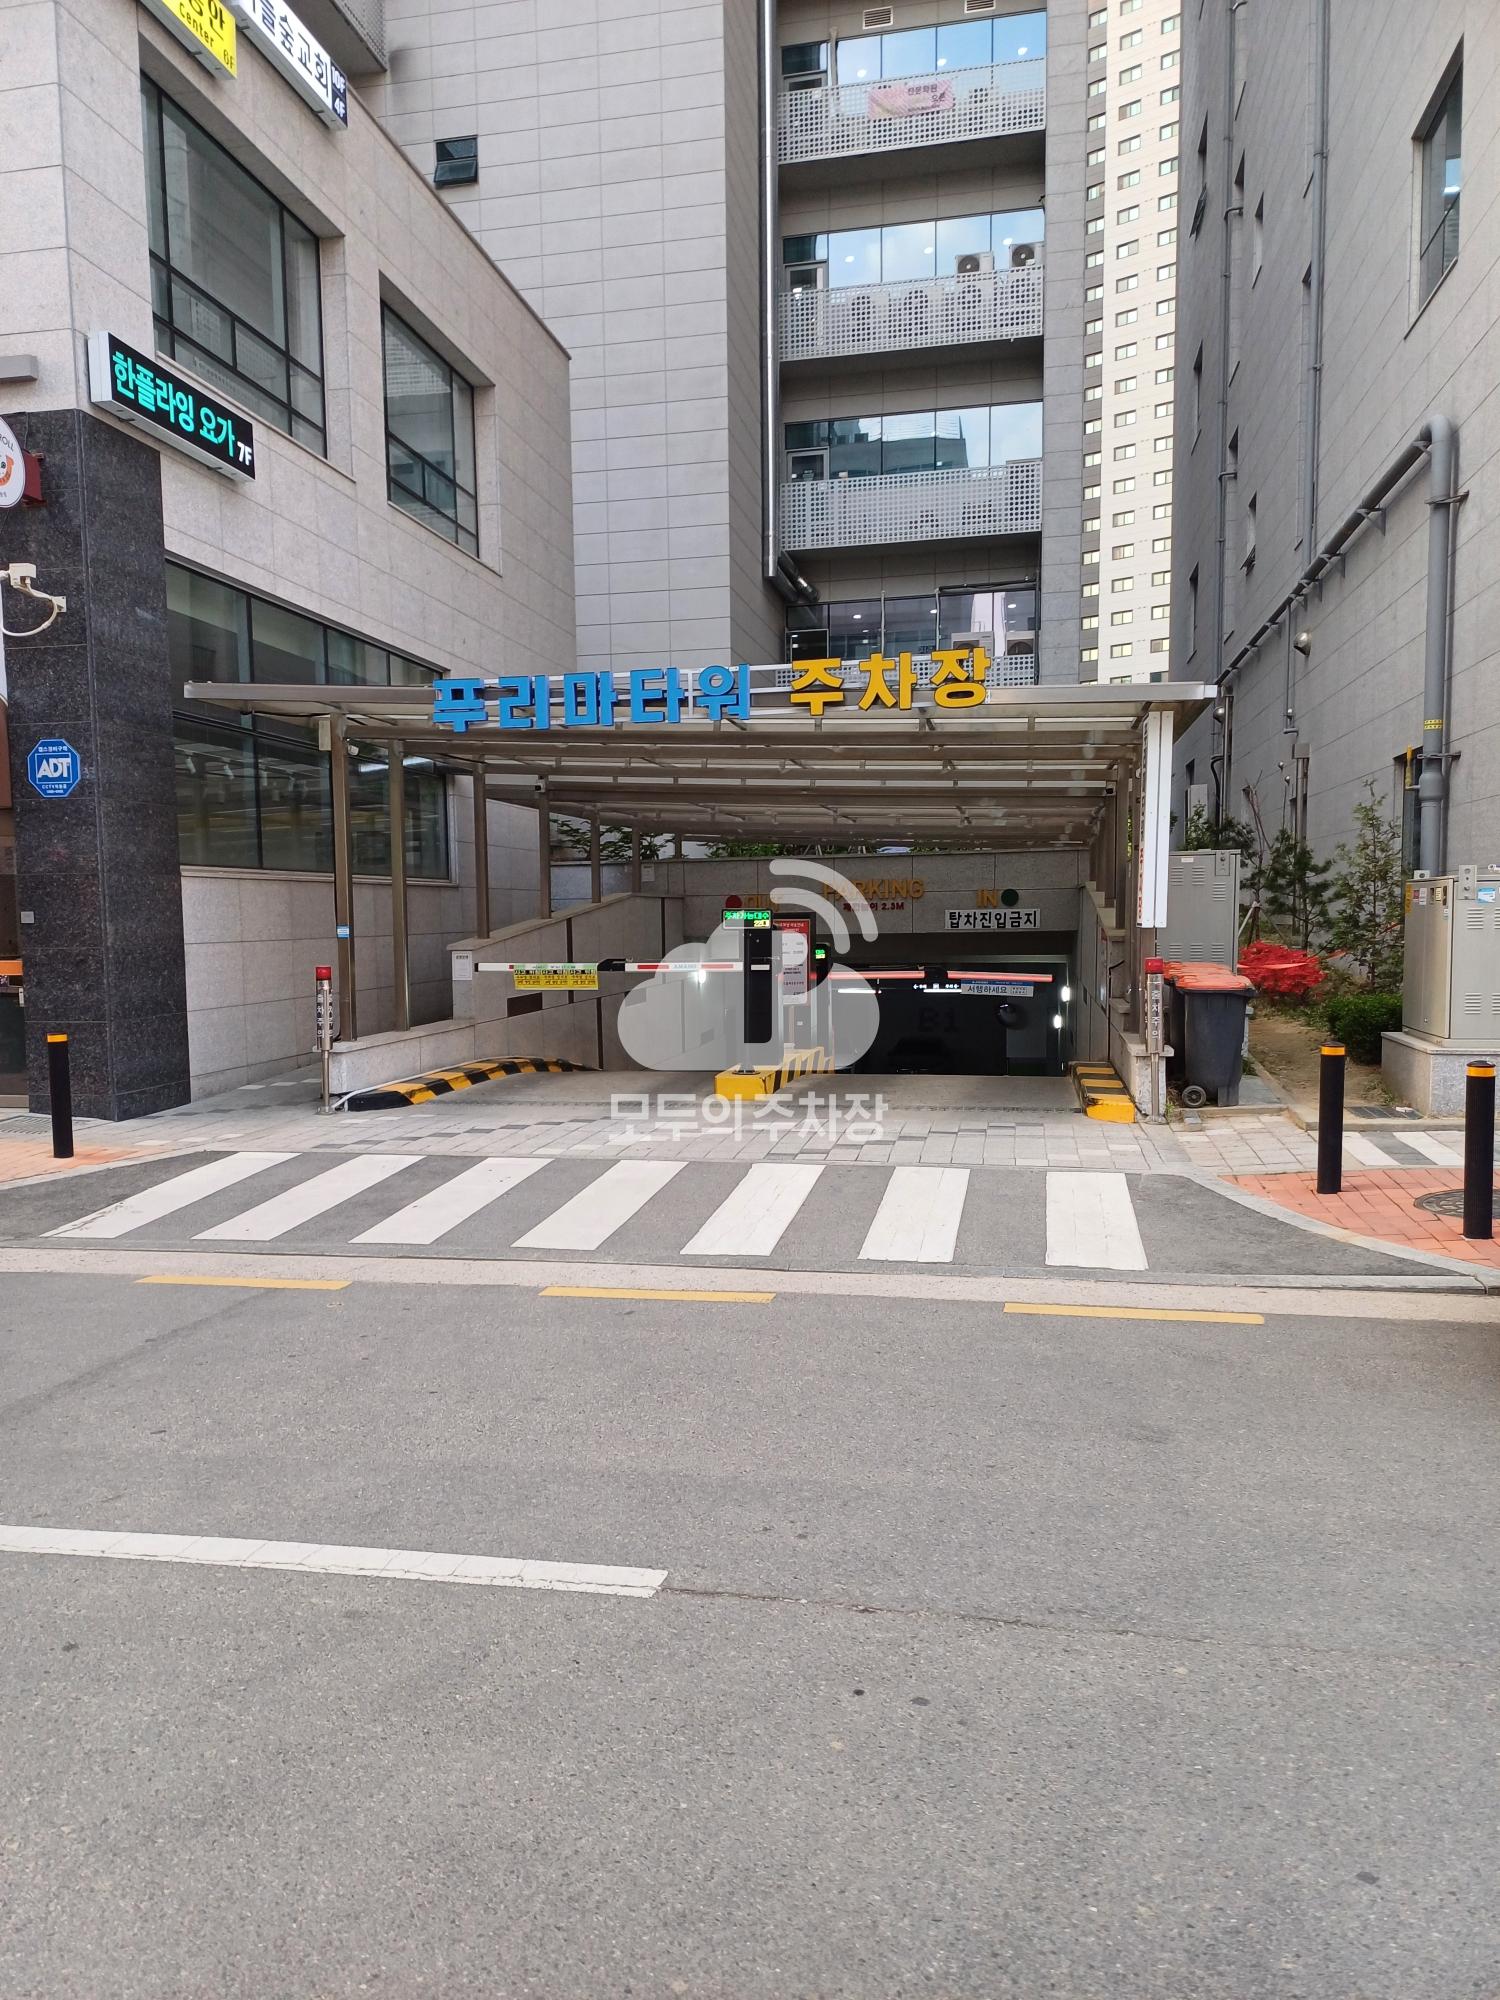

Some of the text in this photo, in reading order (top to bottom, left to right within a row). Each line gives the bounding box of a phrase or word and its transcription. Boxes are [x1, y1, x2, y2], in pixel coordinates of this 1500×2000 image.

[178, 2, 215, 47] Center
[331, 65, 346, 93] 10F
[334, 98, 346, 118] 4F
[112, 351, 252, 466] 한플라잉 요가 7F
[432, 646, 991, 733] 푸리마타워 주차장
[37, 758, 71, 778] ADT
[823, 879, 924, 900] PARKING
[976, 889, 998, 908] IN
[881, 902, 905, 911] 2.3M
[949, 911, 1037, 928] 탑차진입금지
[968, 985, 1008, 994] 서행하세요
